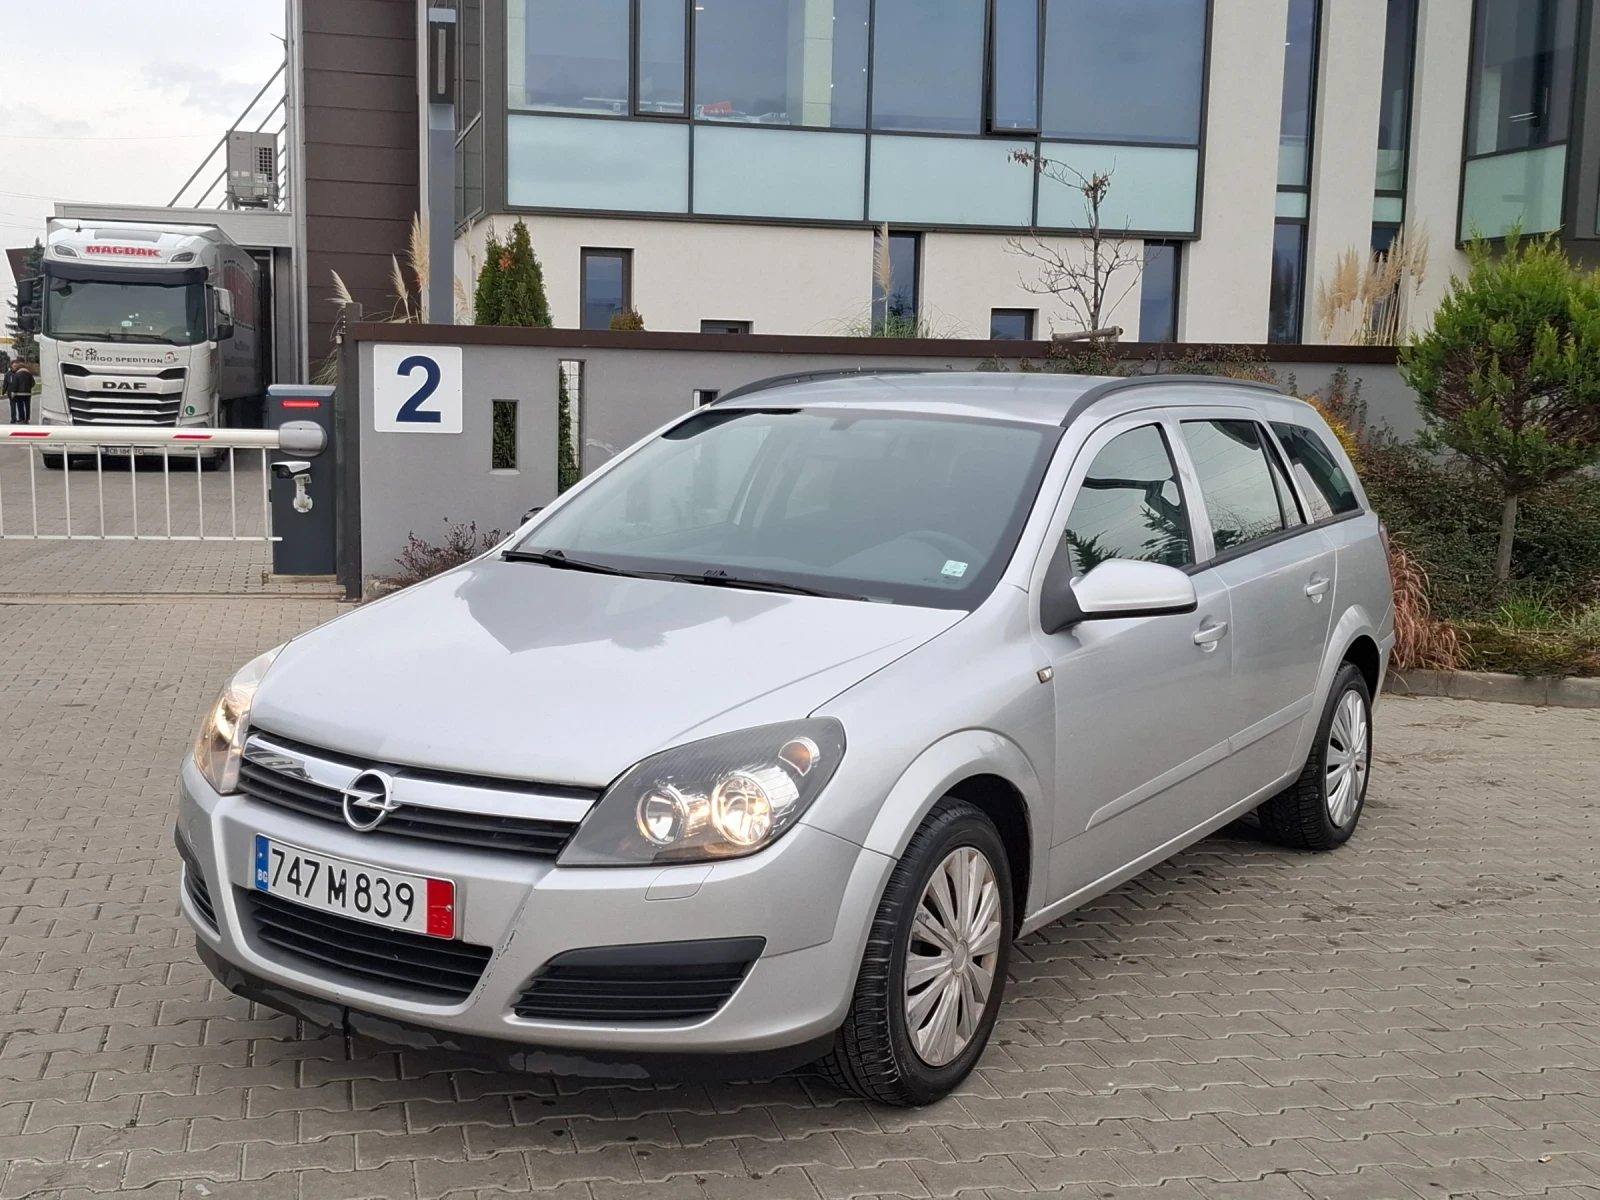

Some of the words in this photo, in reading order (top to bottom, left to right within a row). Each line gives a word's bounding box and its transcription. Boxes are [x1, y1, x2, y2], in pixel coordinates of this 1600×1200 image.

[86, 245, 162, 258] MAGDAK
[102, 381, 147, 391] DAF
[396, 355, 441, 423] 2
[257, 868, 268, 883] BG
[272, 848, 320, 898] 747
[328, 865, 347, 908] M
[354, 872, 414, 922] 839
